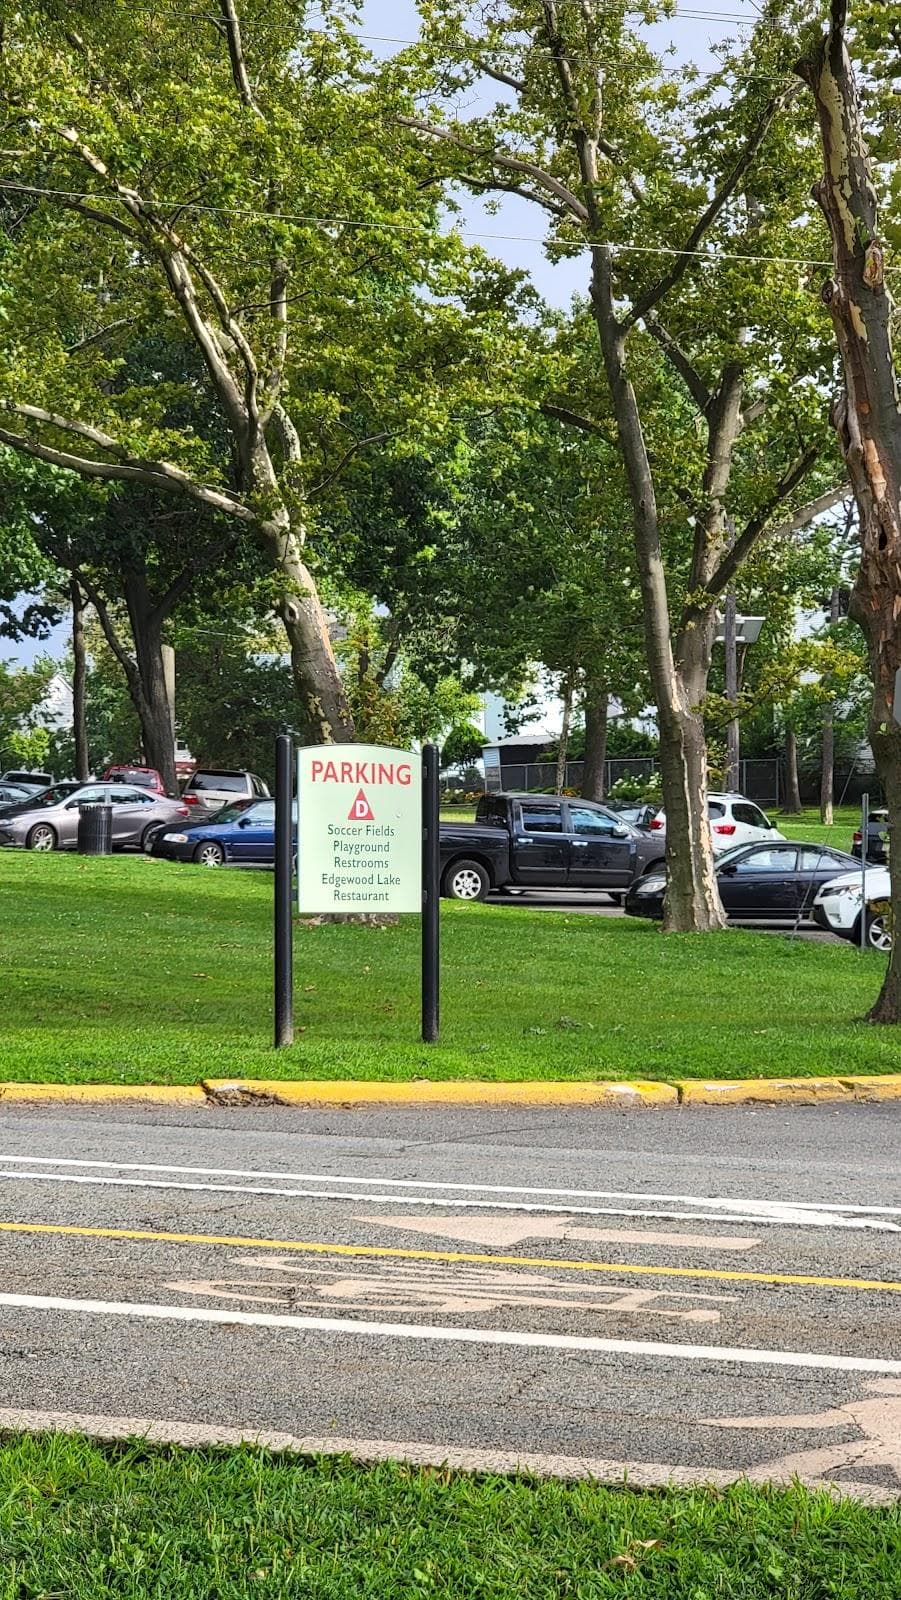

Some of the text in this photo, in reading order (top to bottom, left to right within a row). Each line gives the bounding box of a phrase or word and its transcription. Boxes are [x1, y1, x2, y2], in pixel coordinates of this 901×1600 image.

[311, 760, 411, 786] PARKING
[355, 800, 369, 818] D
[327, 824, 395, 837] Soccer Fields
[333, 841, 390, 855] Playground
[334, 857, 389, 869] Restrooms
[321, 873, 401, 889] Edgewood Lake
[333, 890, 389, 901] Restaurant
